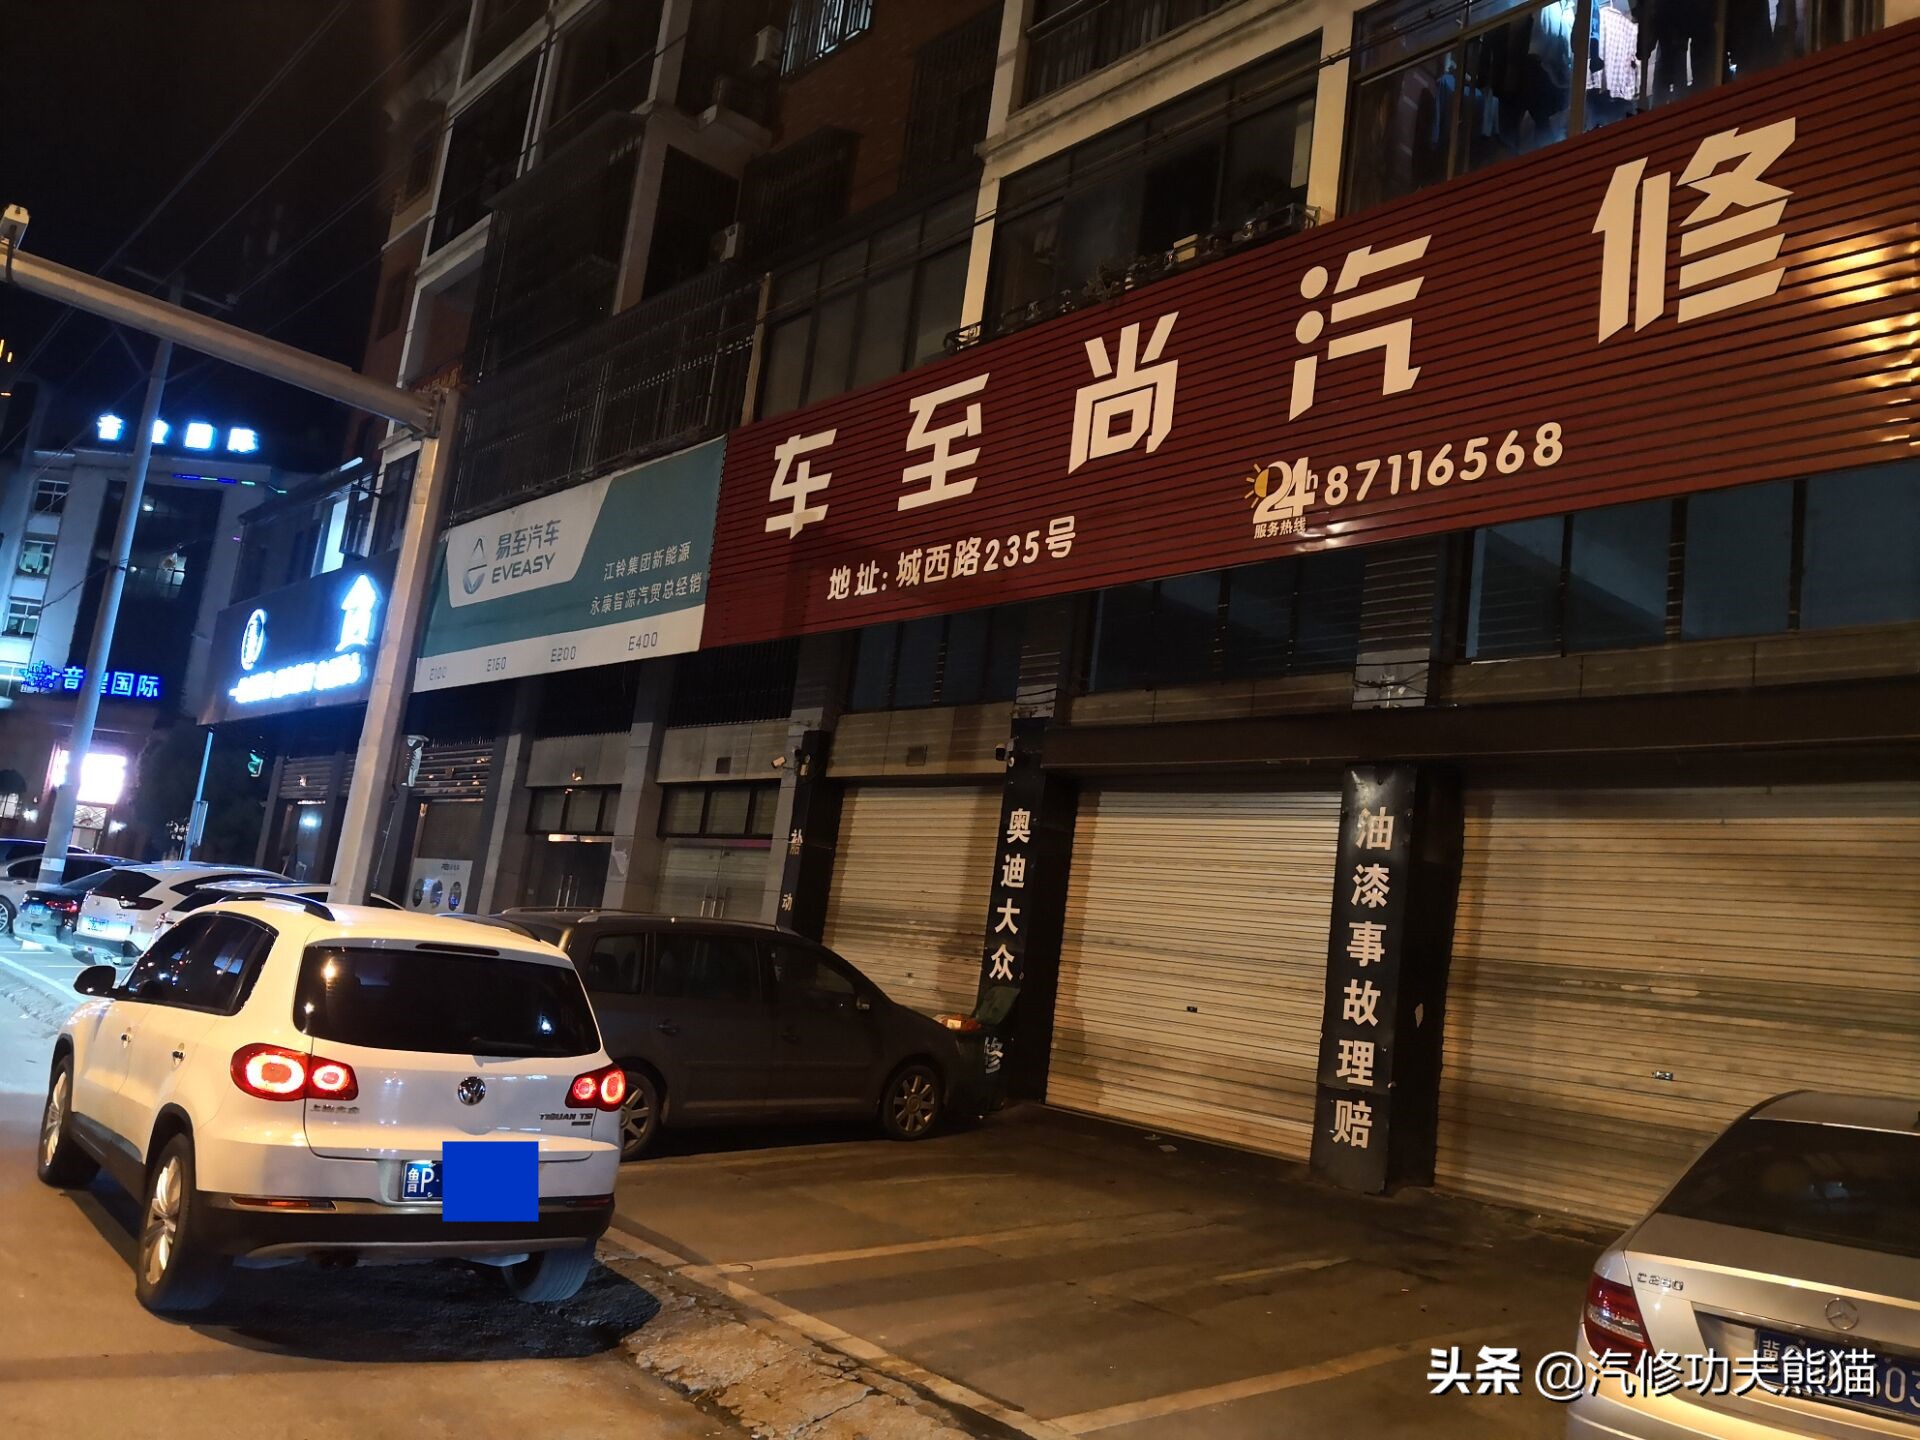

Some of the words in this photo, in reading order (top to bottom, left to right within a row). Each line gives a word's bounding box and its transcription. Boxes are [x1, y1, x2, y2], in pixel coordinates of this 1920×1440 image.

[765, 117, 1796, 539] 车至尚汽修
[1324, 422, 1563, 506] 87116568
[495, 519, 562, 560] 易至汽车
[1254, 516, 1307, 540] 服务热线
[491, 553, 556, 584] EVEASY
[603, 540, 692, 581] 江铃集团新能源
[487, 656, 507, 672] E160
[551, 646, 577, 662] E200
[628, 632, 659, 651] E400
[1332, 806, 1395, 1149] 油漆事故理赔
